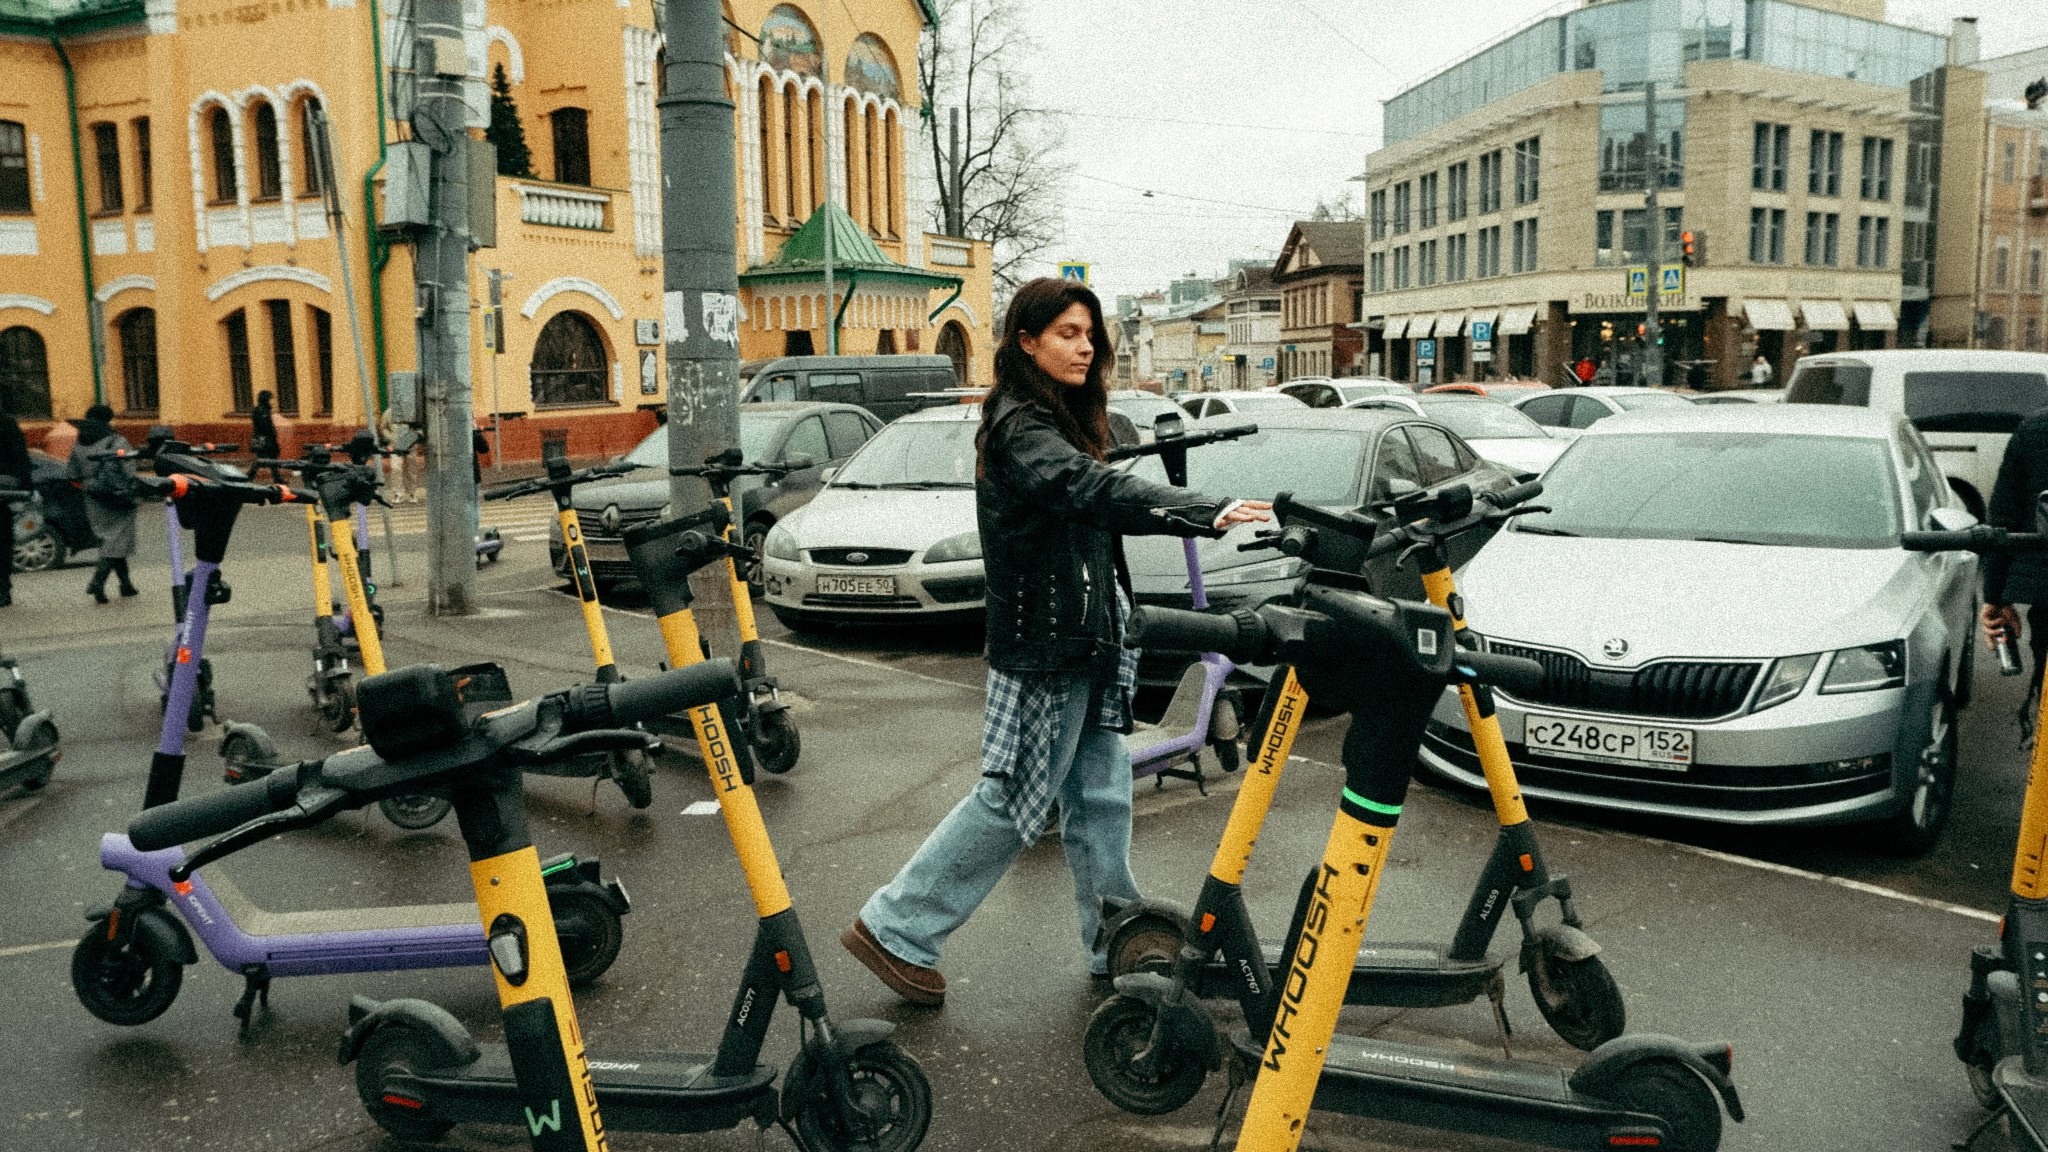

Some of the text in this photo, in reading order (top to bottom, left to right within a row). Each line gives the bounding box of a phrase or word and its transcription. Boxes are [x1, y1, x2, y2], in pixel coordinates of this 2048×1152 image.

[697, 706, 737, 793] HOOSH
[1258, 695, 1297, 775] WHOOSH
[1533, 722, 1636, 753] С248СР
[1643, 730, 1685, 752] 152
[1652, 750, 1672, 758] RUS
[1239, 959, 1261, 994] AC1767
[1264, 863, 1339, 1072] WHOOSH
[588, 1061, 640, 1071] WHOO
[1362, 1050, 1455, 1071] WHOOSH
[525, 1099, 561, 1136] W
